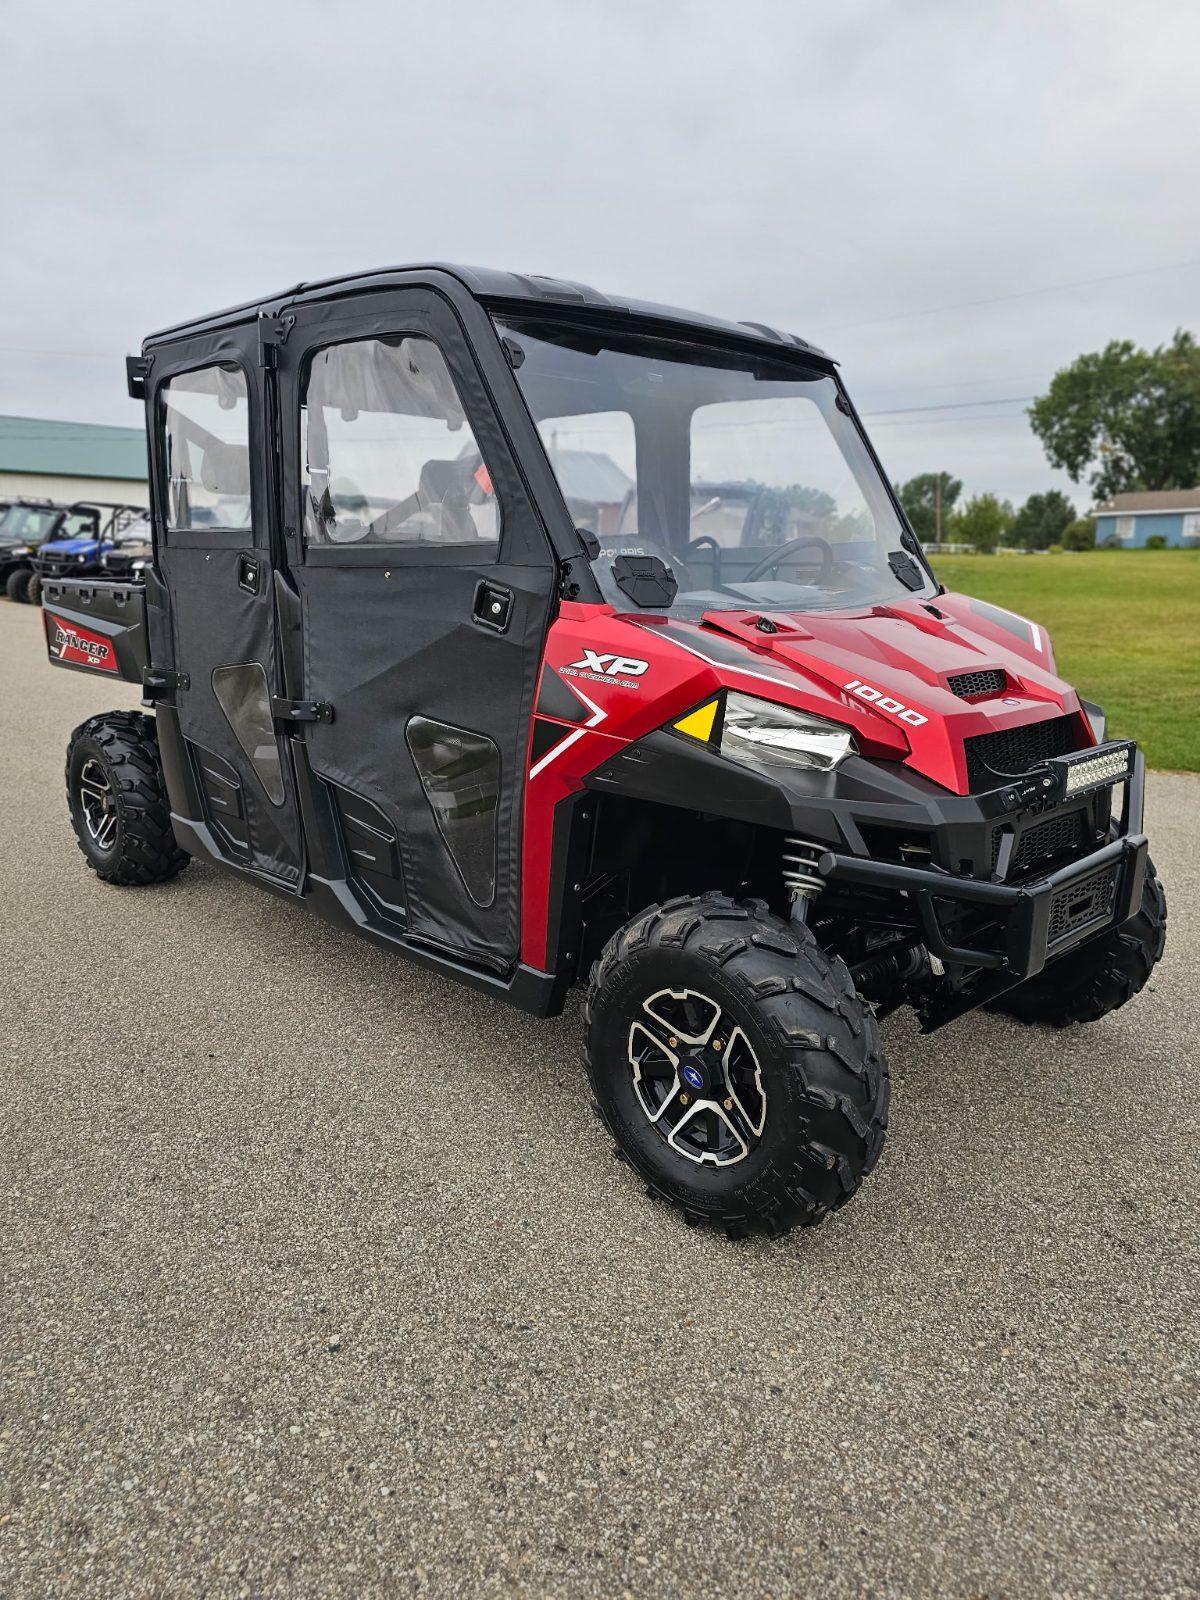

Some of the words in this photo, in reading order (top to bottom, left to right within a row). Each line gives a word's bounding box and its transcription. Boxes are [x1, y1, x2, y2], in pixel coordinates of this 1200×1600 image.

[599, 547, 645, 558] POLARIS
[56, 629, 109, 660] RANGER
[87, 655, 101, 664] XP
[568, 648, 650, 677] XP
[843, 680, 929, 726] 1000
